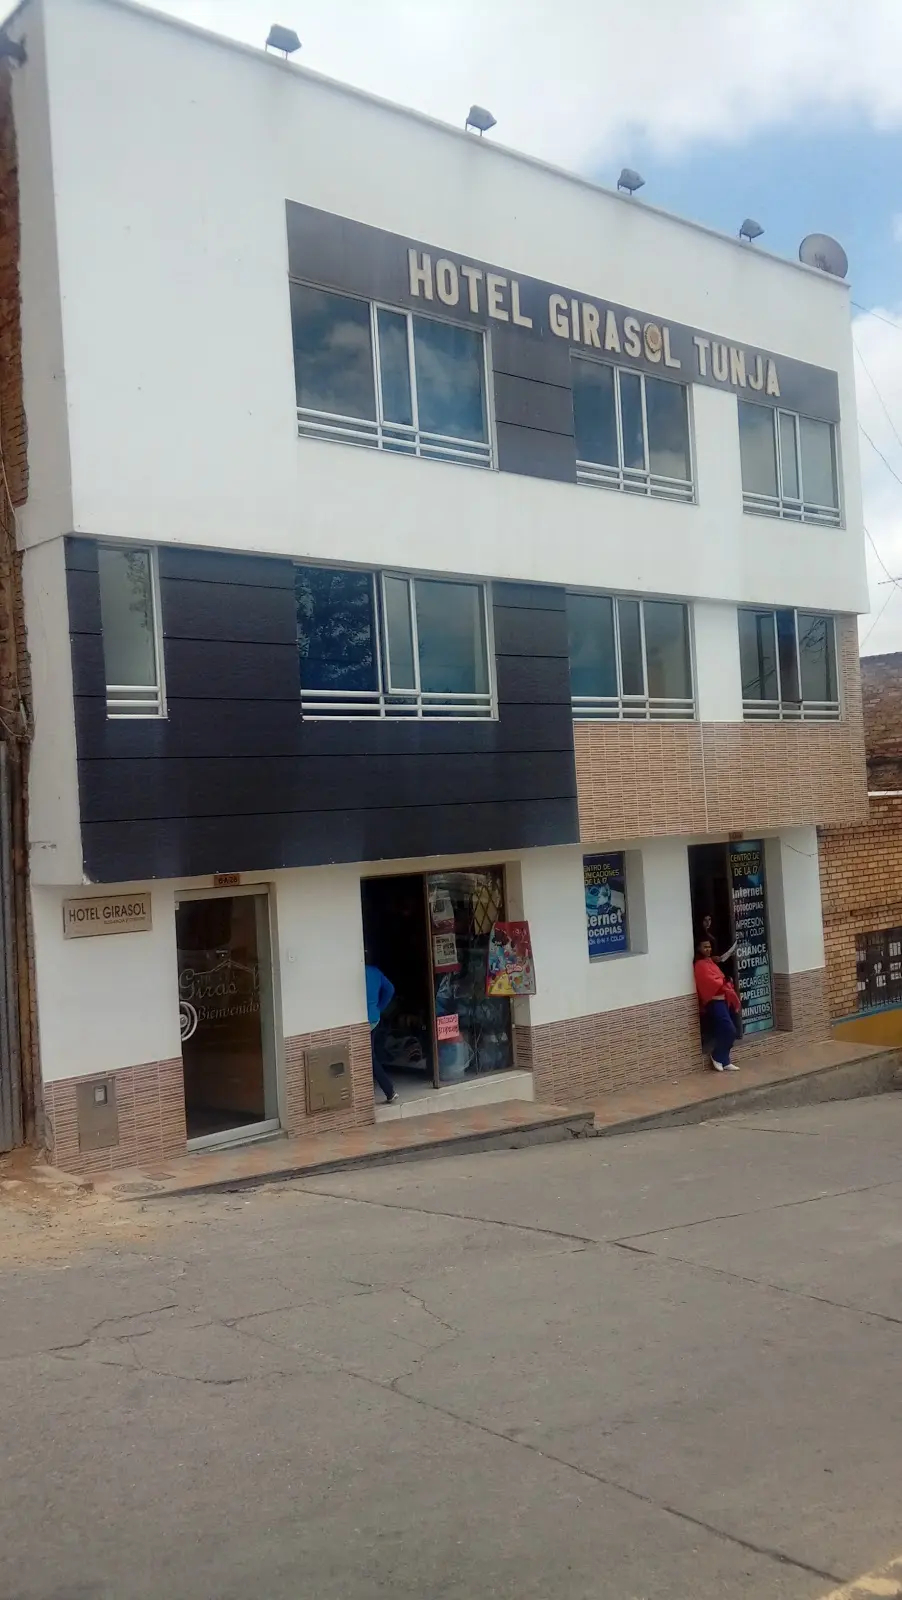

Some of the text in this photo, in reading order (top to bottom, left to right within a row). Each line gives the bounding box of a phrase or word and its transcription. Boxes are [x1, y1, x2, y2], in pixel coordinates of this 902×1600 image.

[408, 248, 781, 397] HOTEL GIRASOL TUNJA
[730, 852, 760, 862] CENTRO DE
[583, 864, 602, 872] ENTRO
[734, 867, 743, 877] DE
[743, 866, 752, 875] LA
[594, 877, 602, 885] LA
[732, 884, 763, 899] Internet
[69, 907, 100, 922] HOTEL
[102, 902, 147, 919] GIRASOL
[588, 925, 623, 938] OCOPIAS
[736, 943, 767, 958] CHANCE
[739, 973, 770, 989] RECARGAS
[197, 998, 261, 1022] Bienvenido
[741, 1003, 771, 1018] MINUTOS
